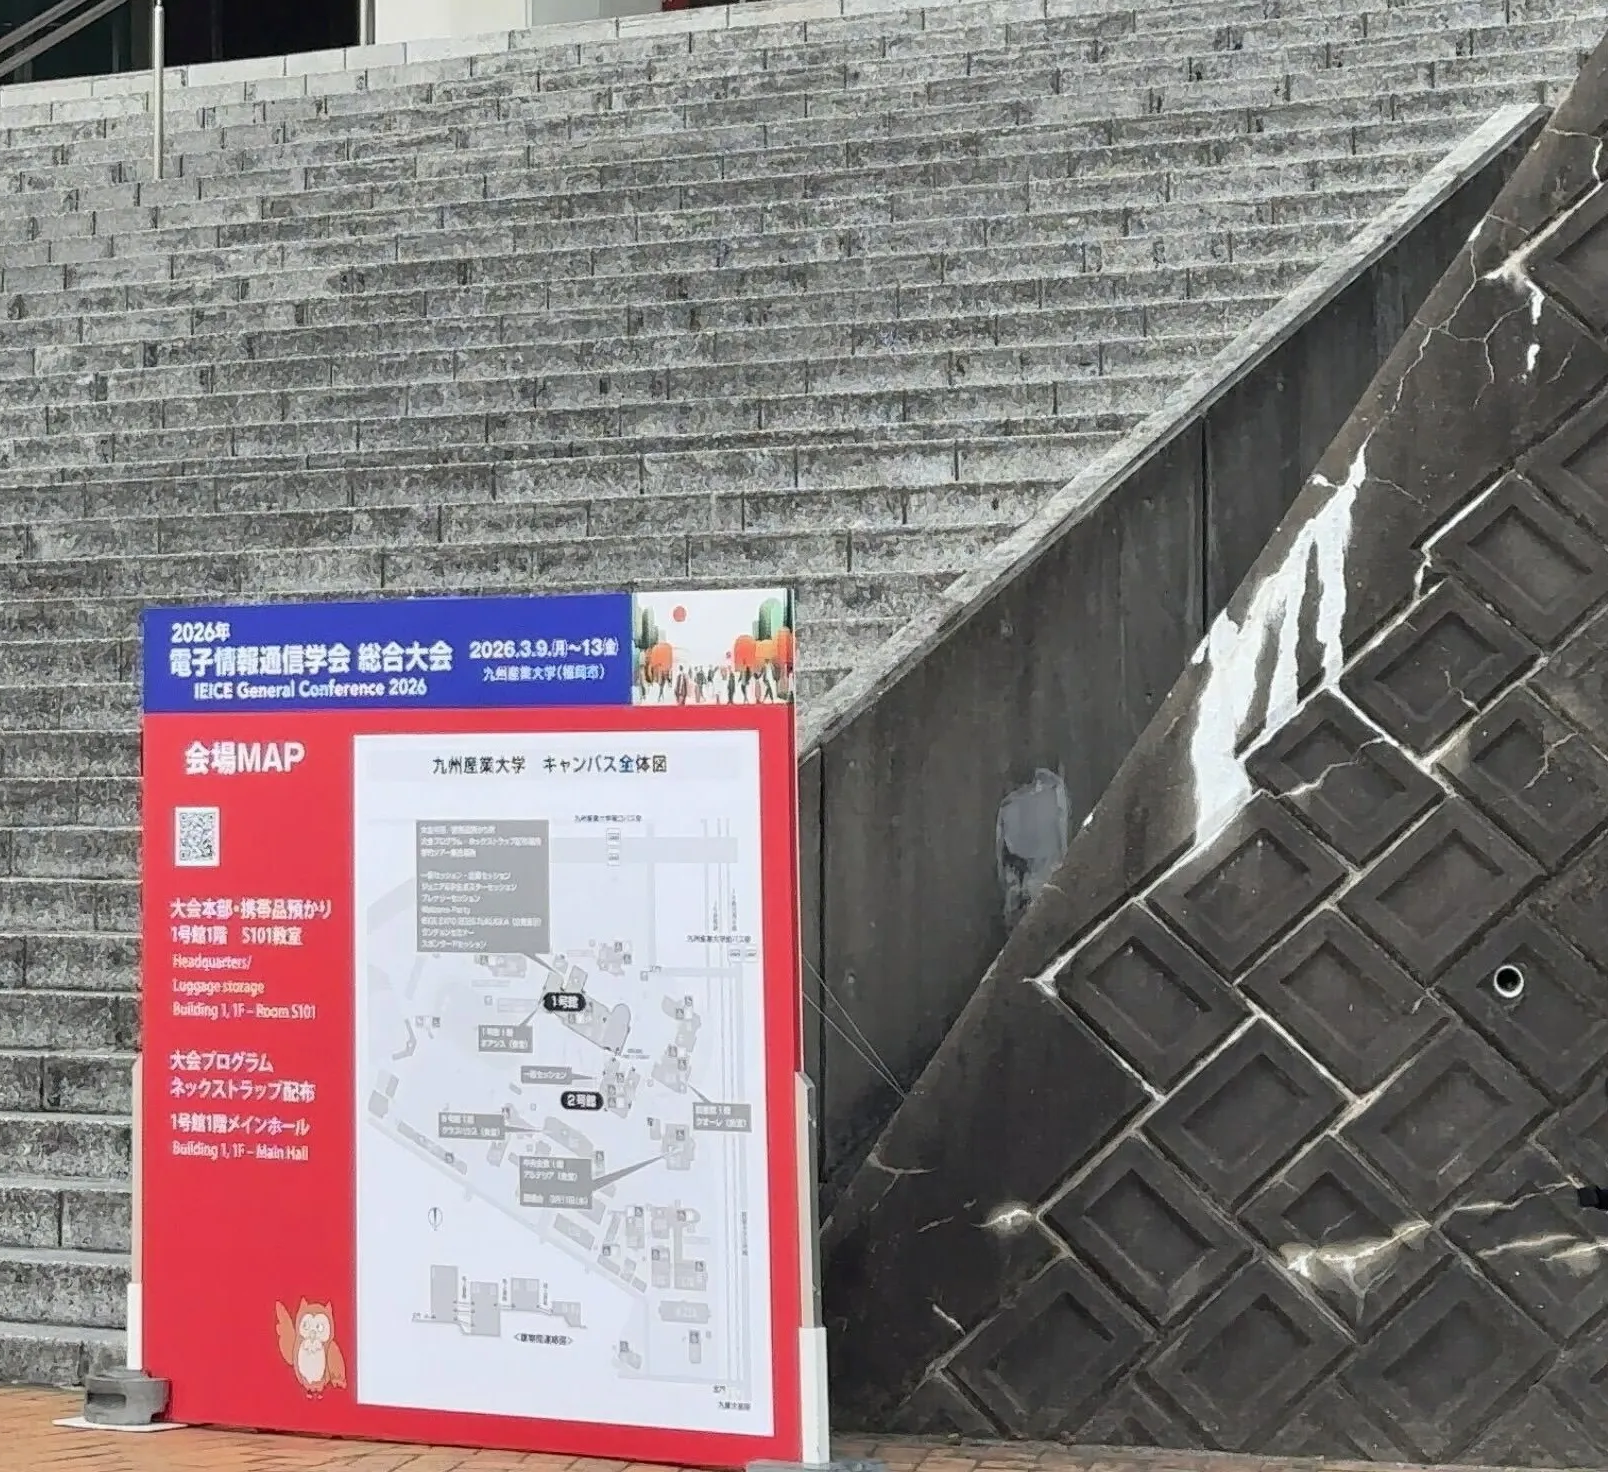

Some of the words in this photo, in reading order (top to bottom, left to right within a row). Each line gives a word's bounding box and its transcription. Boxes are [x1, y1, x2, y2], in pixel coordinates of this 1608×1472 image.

[170, 622, 231, 643] 2026年
[169, 643, 351, 678] 電子情報通信学会
[358, 640, 454, 673] 総合大会
[194, 682, 233, 700] IEICE
[237, 679, 295, 699] General
[299, 680, 385, 698] Conference
[388, 678, 428, 696] 2026
[185, 740, 306, 775] 会場MAP
[432, 755, 526, 775] 九州産業大学
[543, 754, 668, 774] キャンパス全体図
[173, 979, 220, 996] Luggage
[223, 981, 265, 997] storage
[173, 1001, 218, 1020] Building
[256, 1004, 290, 1018] Room
[169, 1049, 274, 1073] 大会プログラム
[170, 1076, 316, 1103] ネックストラップ配布
[170, 1112, 311, 1137] 1号館1階メインホール
[173, 1140, 218, 1160] Building
[256, 1144, 284, 1159] Main
[286, 1145, 309, 1161] Hall
